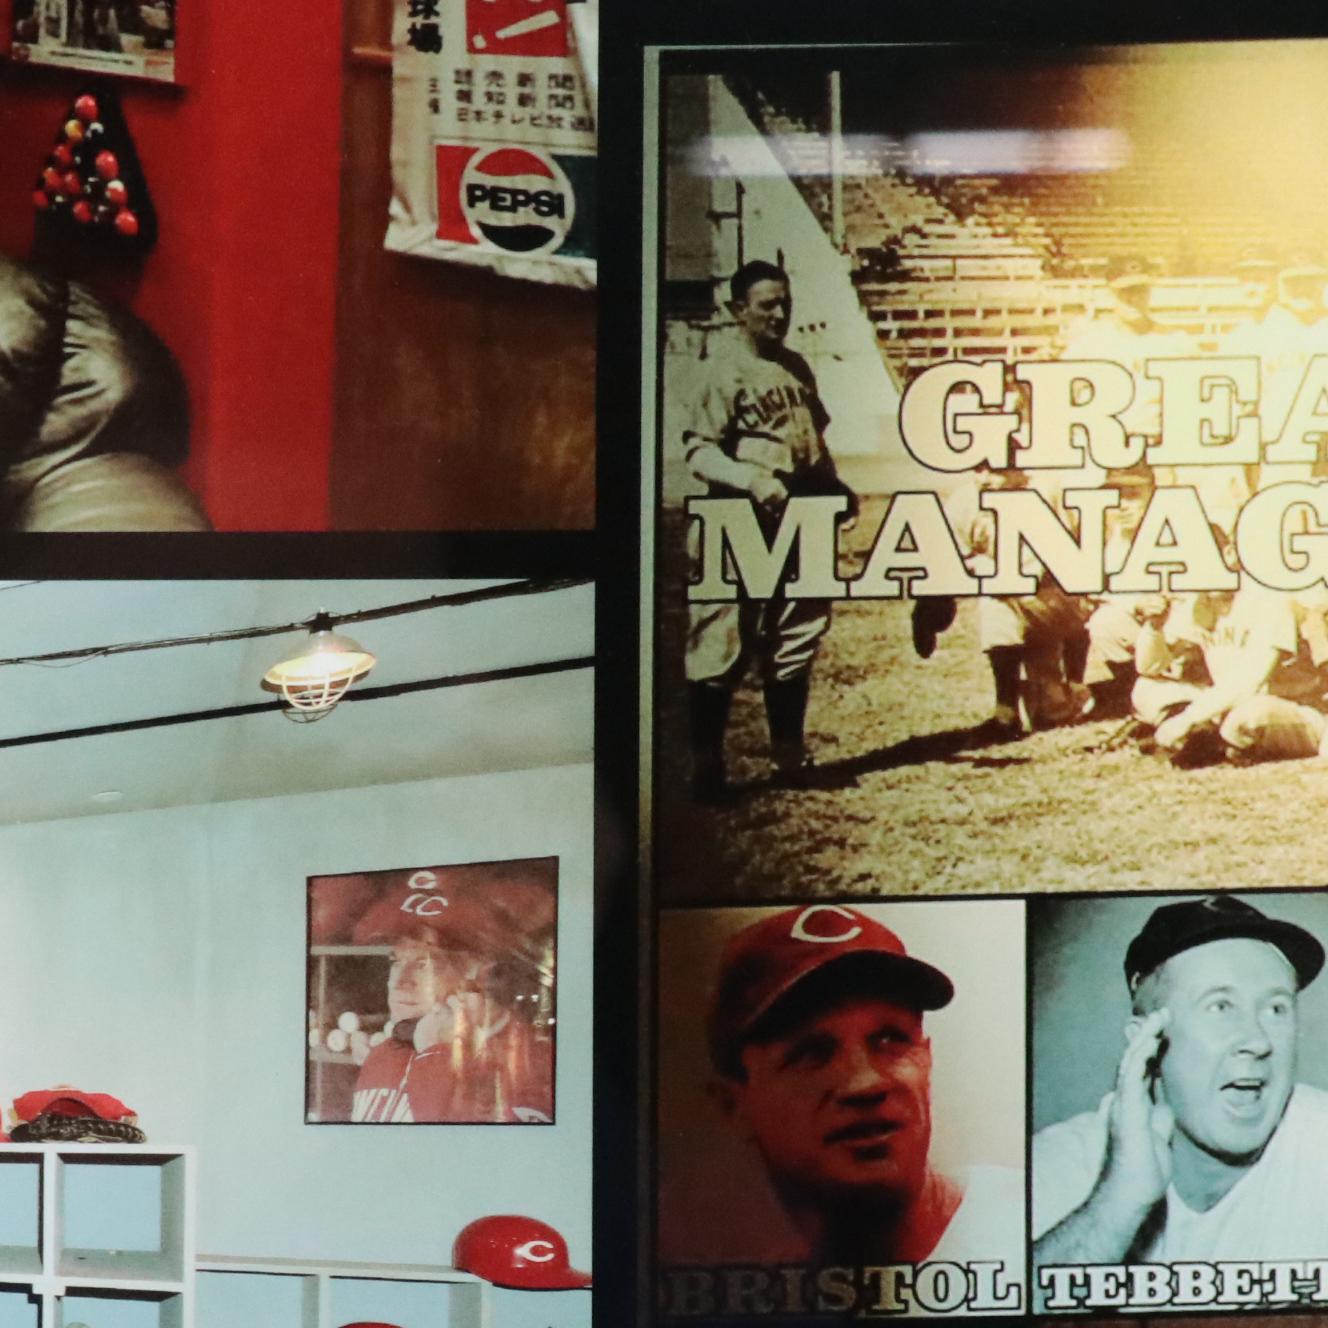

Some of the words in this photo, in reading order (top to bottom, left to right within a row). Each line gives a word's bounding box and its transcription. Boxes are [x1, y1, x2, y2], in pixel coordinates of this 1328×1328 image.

[467, 183, 566, 219] PEPSI
[687, 481, 1328, 602] MANAG
[669, 1261, 1022, 1316] BRISTOL
